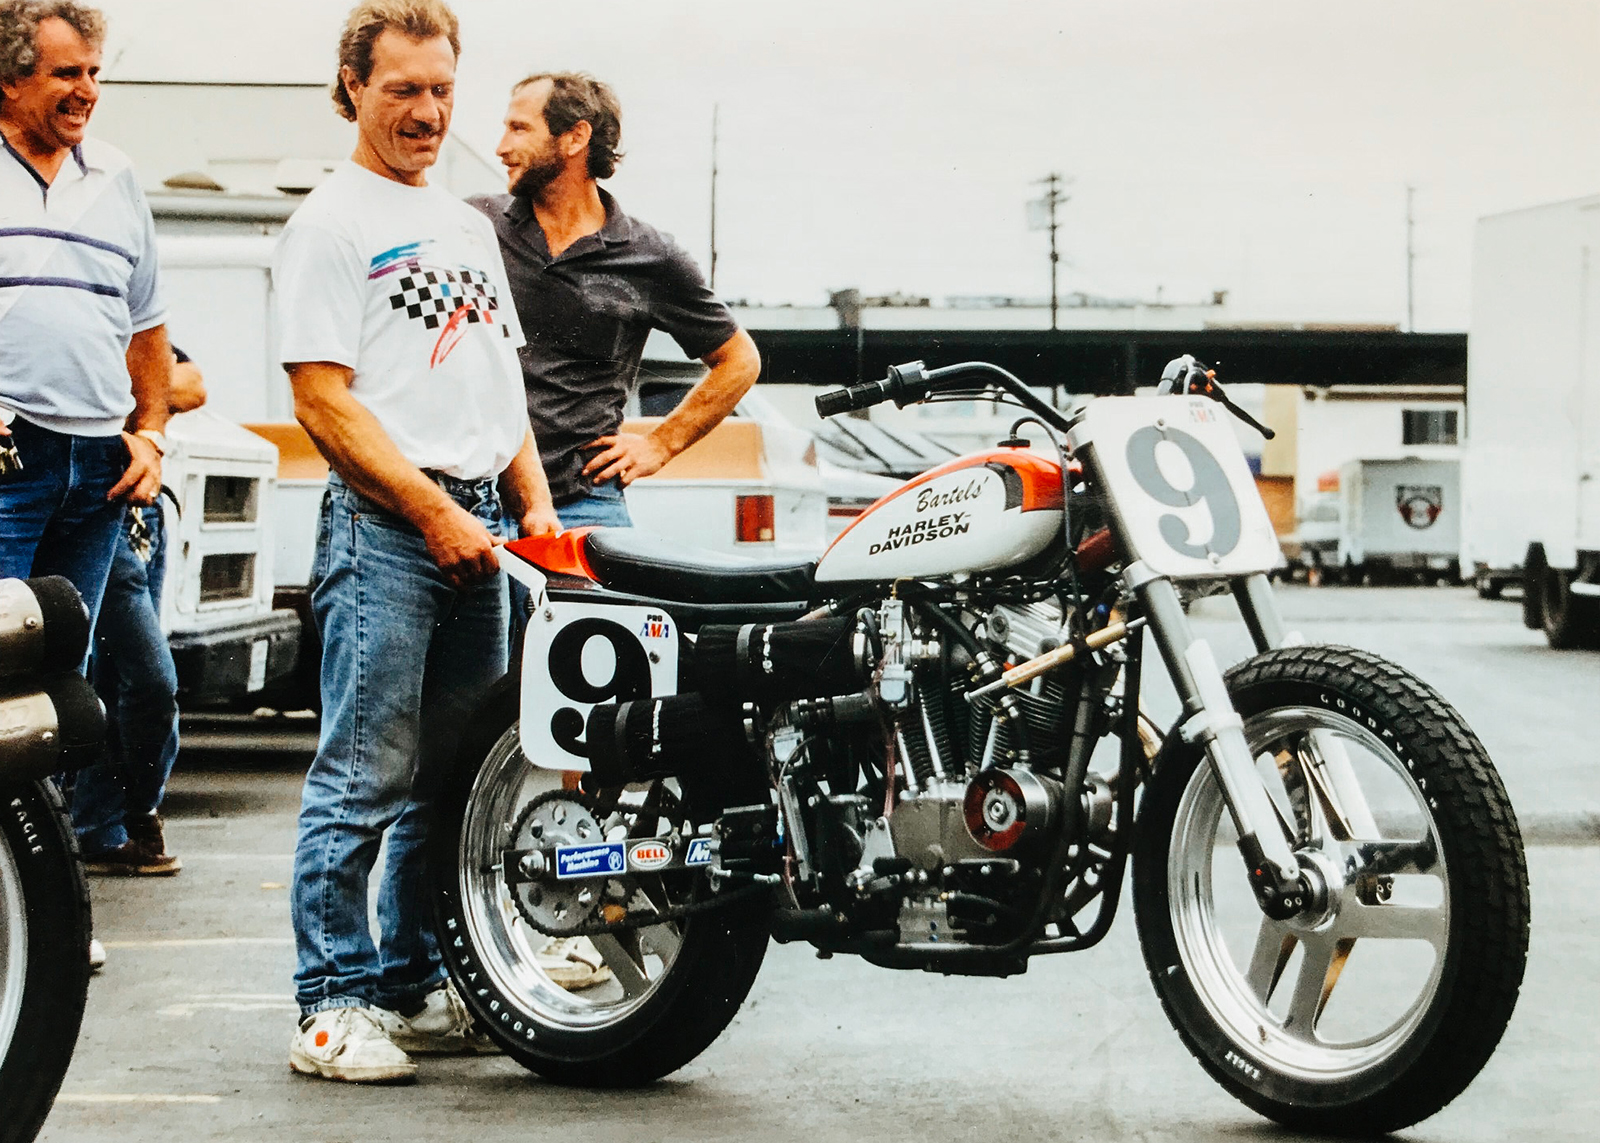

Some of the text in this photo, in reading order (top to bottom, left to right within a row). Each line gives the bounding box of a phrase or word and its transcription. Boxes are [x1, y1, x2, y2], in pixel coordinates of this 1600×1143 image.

[916, 476, 989, 513] Bartels'
[1125, 425, 1241, 560] 9
[869, 522, 970, 555] DAVIDSON
[888, 511, 971, 539] HARLEY-
[640, 622, 669, 638] AMA
[647, 614, 663, 622] PRO
[548, 617, 652, 758] 9
[636, 847, 666, 859] BELL
